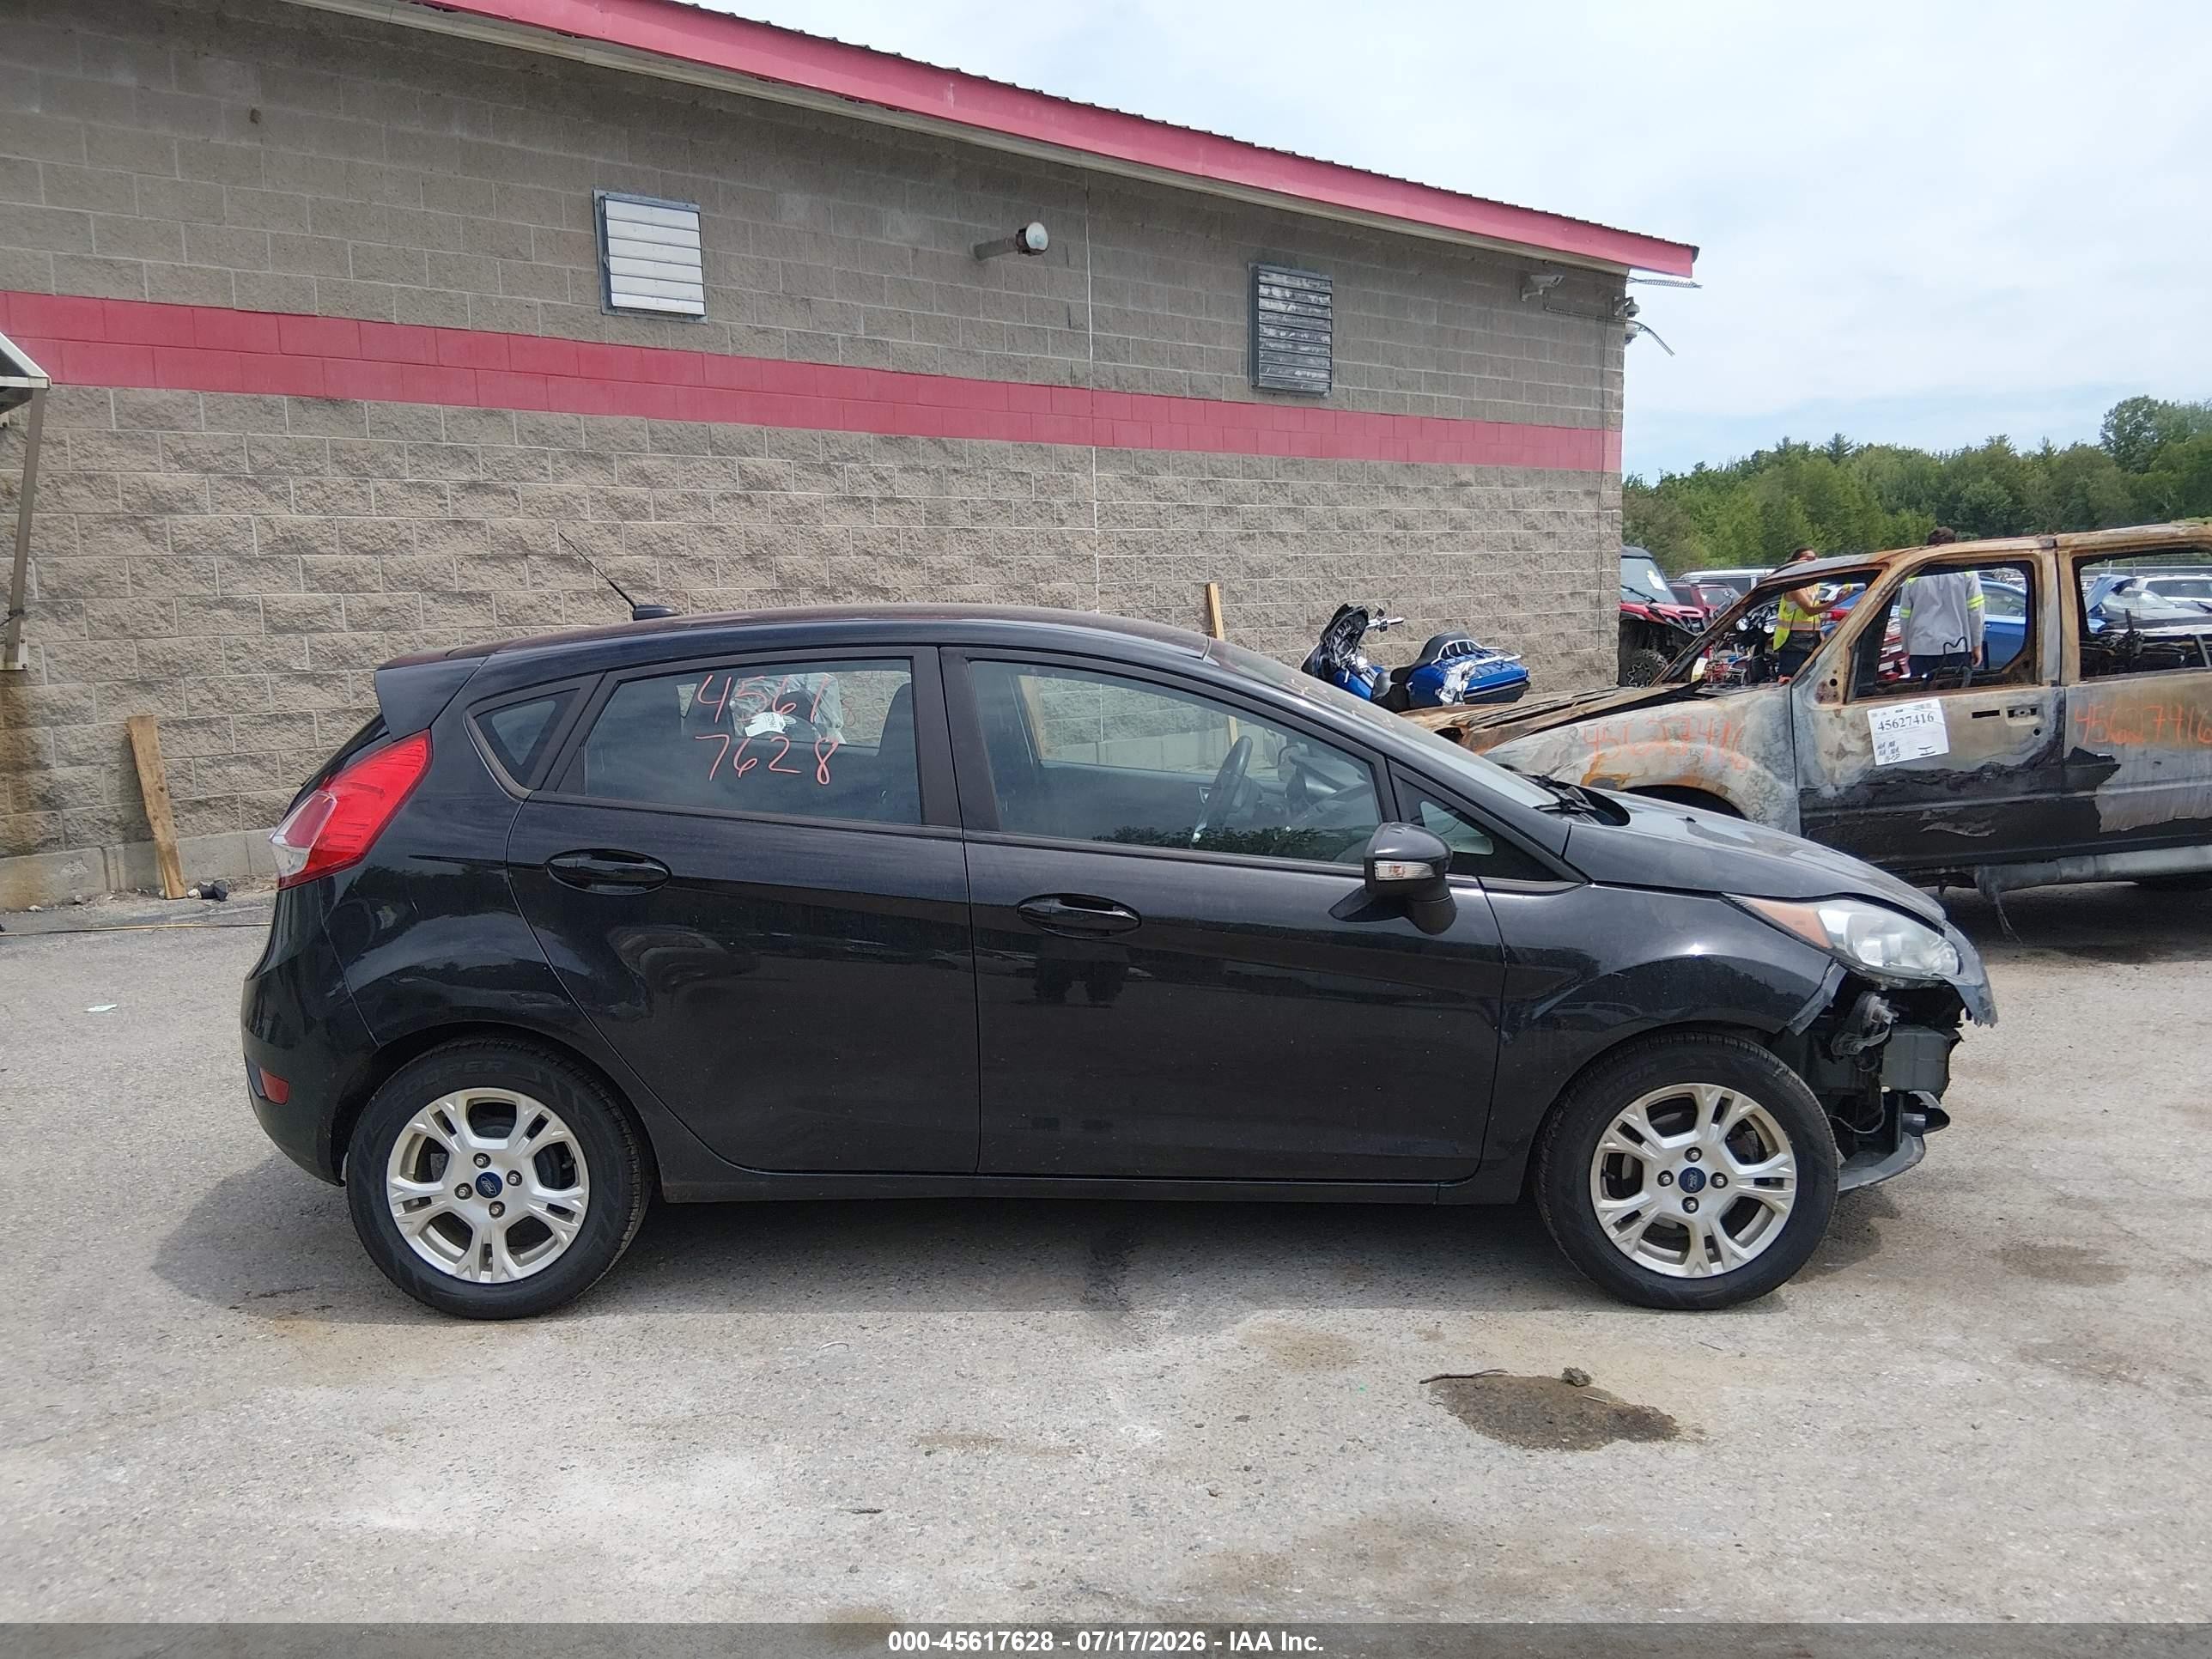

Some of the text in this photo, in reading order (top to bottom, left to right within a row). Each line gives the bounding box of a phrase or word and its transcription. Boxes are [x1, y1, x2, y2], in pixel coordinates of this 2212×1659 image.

[696, 673, 830, 724] 4561
[1877, 713, 1935, 731] 45627416
[694, 733, 839, 785] 7628
